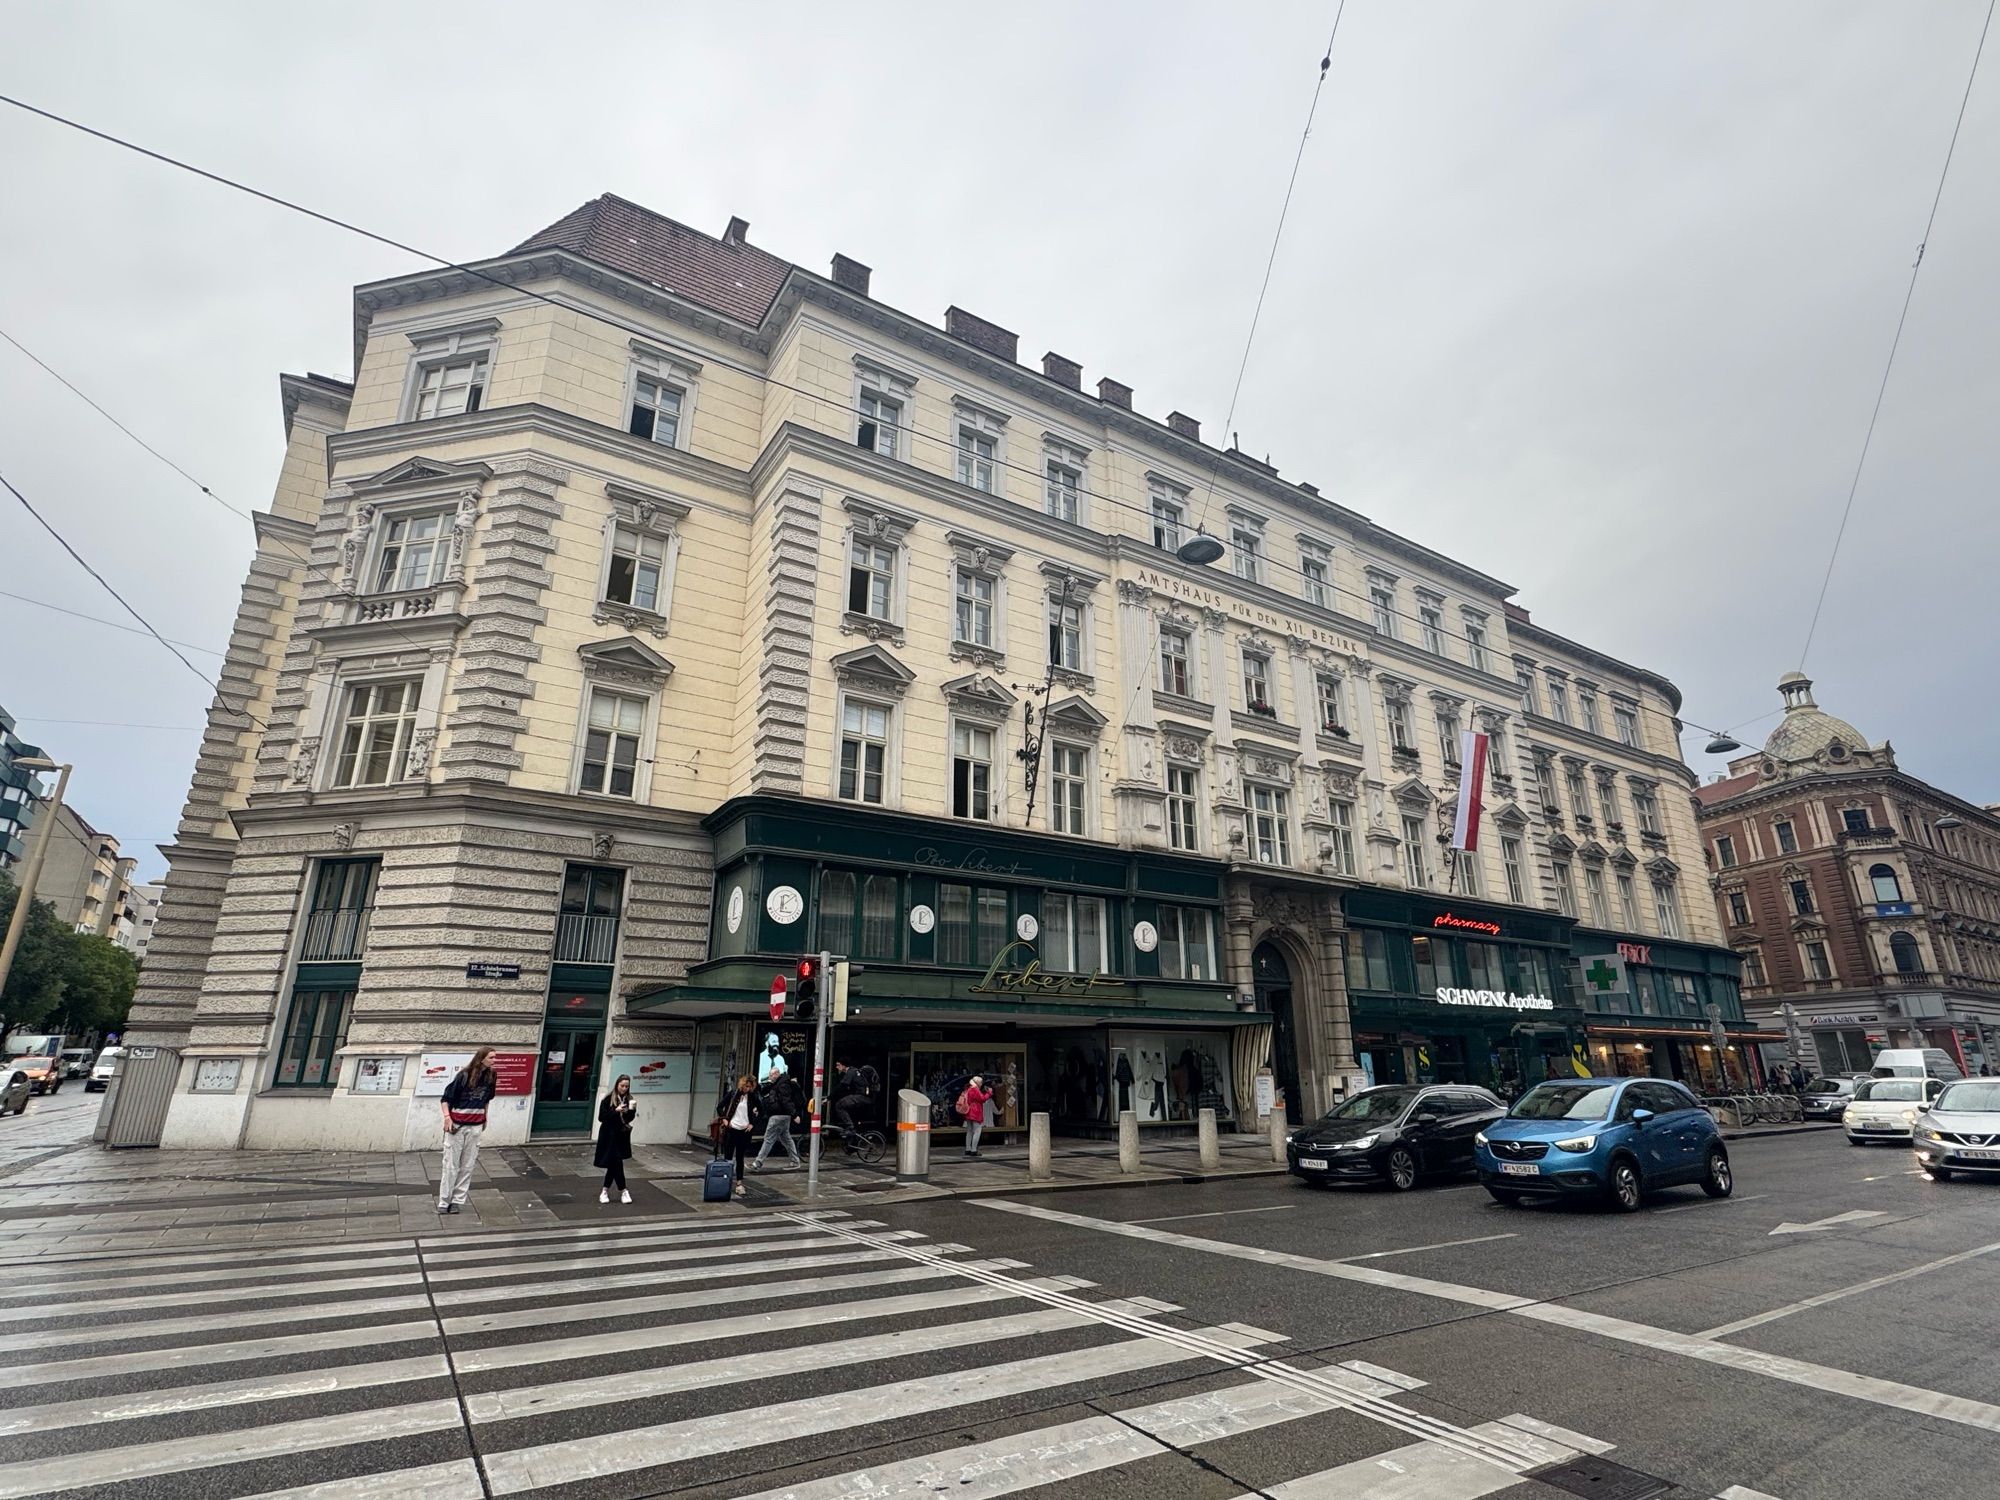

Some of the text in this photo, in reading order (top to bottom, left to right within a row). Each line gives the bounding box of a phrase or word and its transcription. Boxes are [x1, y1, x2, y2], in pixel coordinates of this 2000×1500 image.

[1138, 569, 1358, 653] AMTSHAUS FÜR DEN XII. BEZIRK
[1434, 912, 1501, 935] pharmacy
[481, 965, 518, 973] Schönbrunner
[968, 941, 1126, 993] Libert
[1436, 987, 1554, 1012] SCHWENK Apotheke
[1817, 1016, 1833, 1024] Bank
[1834, 1015, 1856, 1024] Austria
